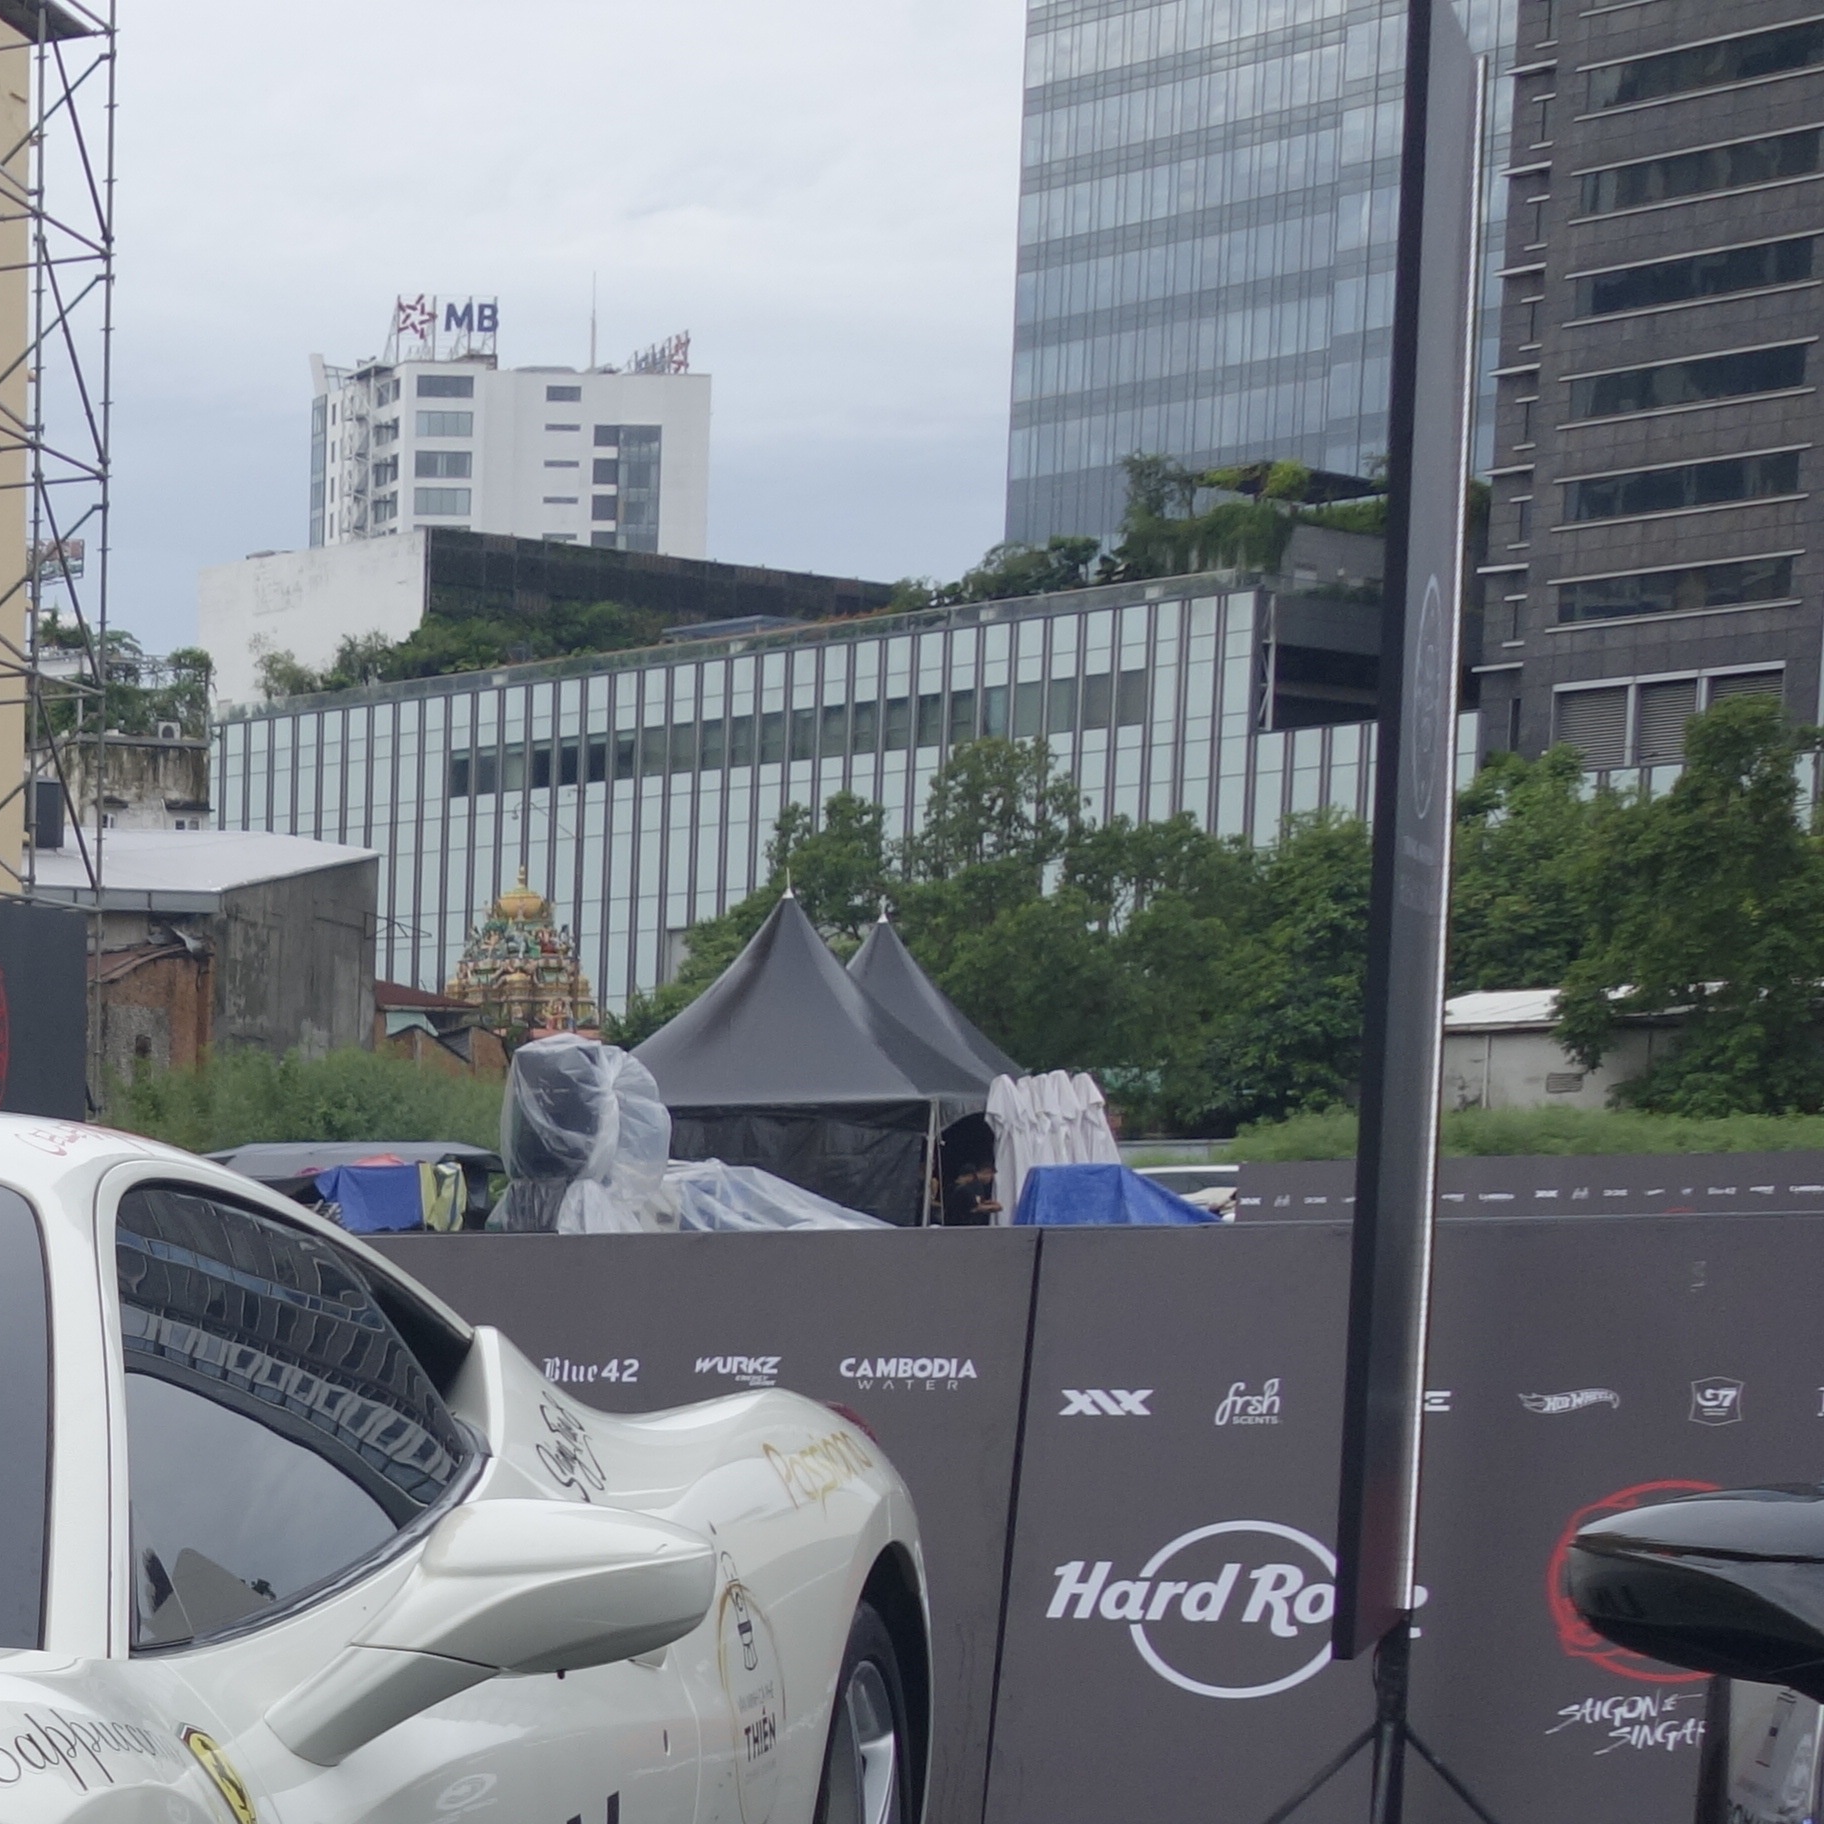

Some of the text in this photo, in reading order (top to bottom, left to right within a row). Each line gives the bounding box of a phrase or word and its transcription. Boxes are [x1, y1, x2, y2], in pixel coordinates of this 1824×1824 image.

[444, 303, 499, 333] MB
[694, 1356, 782, 1375] WURKZ
[839, 1357, 978, 1379] CAMBODIA
[857, 1379, 959, 1391] WATER
[1232, 1416, 1278, 1425] SCENTS
[1046, 1561, 1241, 1622] Hard
[1593, 1718, 1706, 1756] SINGA
